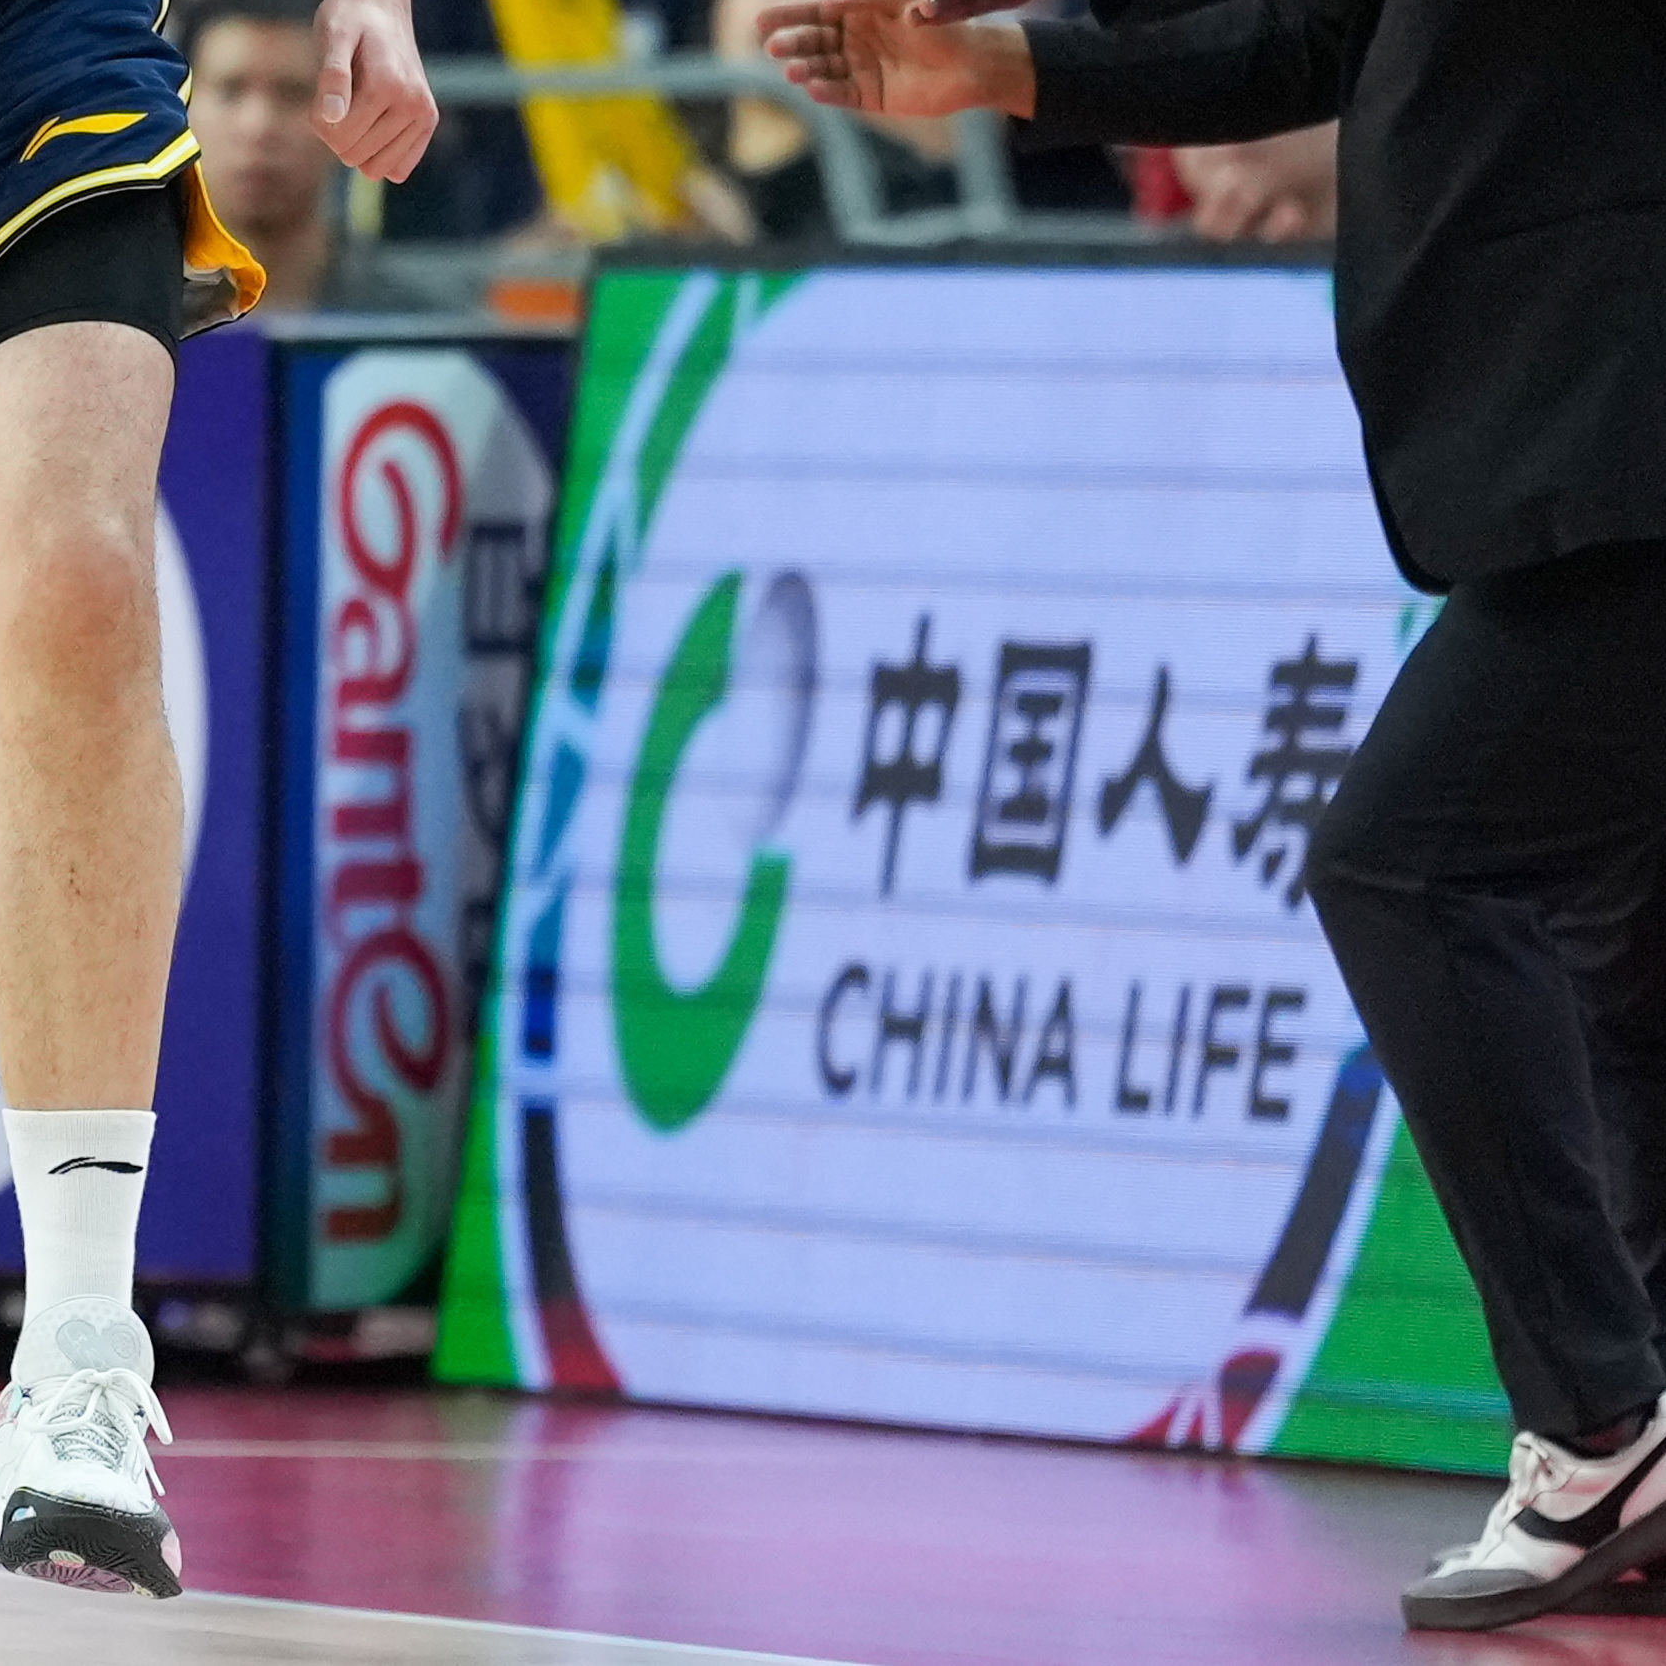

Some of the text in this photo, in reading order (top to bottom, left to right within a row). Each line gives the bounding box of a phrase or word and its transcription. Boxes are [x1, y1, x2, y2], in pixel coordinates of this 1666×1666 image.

[847, 612, 1361, 909] 中国人寿
[813, 962, 1309, 1124] CHINA LIFE
